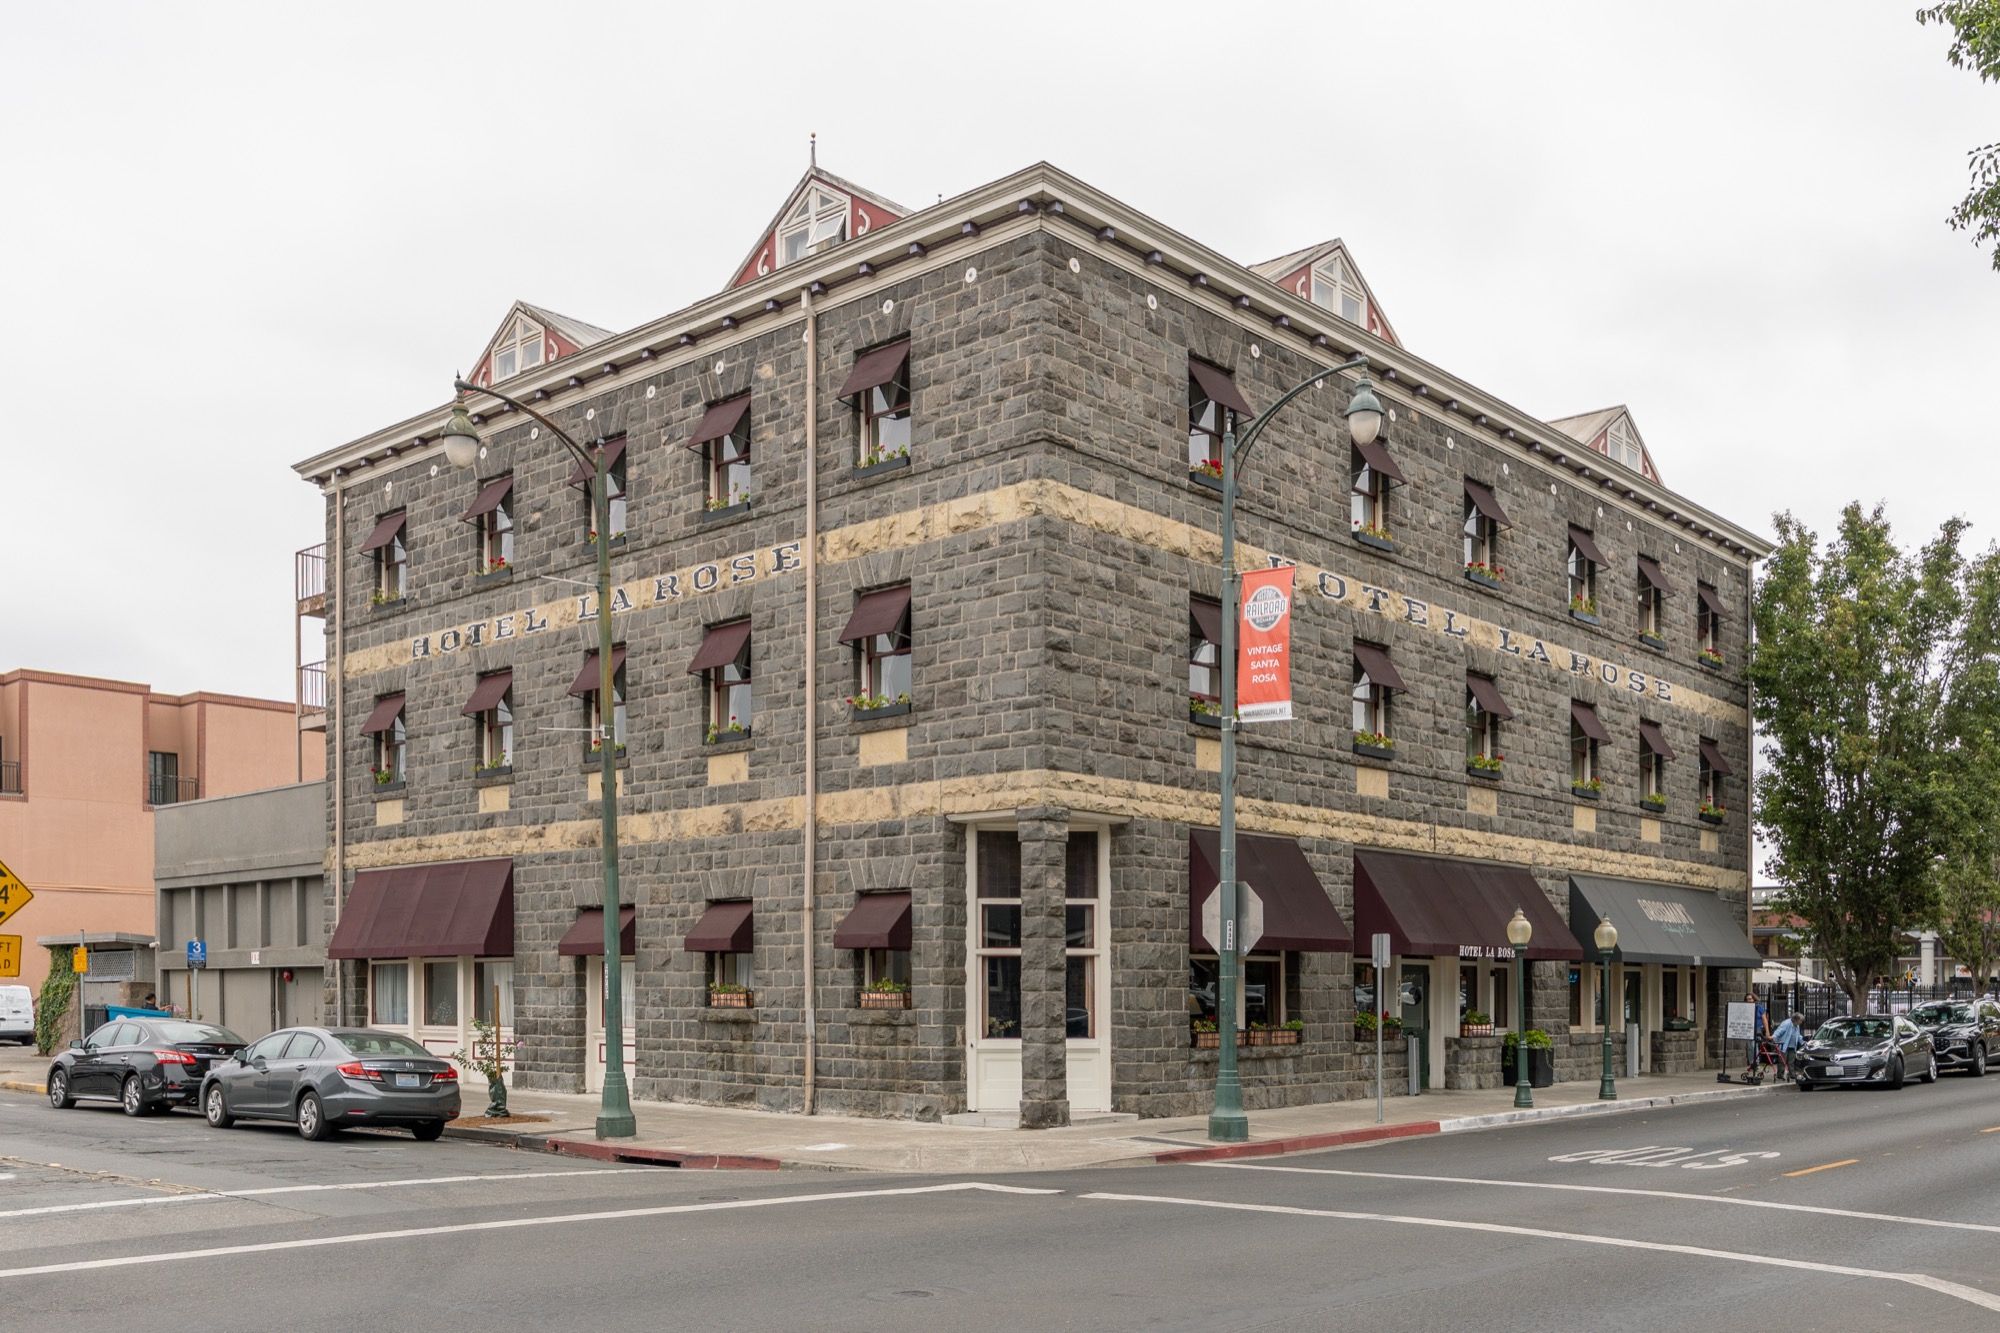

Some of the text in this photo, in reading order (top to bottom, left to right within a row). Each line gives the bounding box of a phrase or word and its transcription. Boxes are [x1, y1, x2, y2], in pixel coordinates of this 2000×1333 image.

[412, 543, 800, 658] HOTEL LA ROSE
[1246, 599, 1286, 617] RAILROAD
[1247, 643, 1282, 656] VINTAGE
[1250, 659, 1280, 670] SANTA
[1499, 629, 1551, 664] LA
[1570, 652, 1671, 702] ROSE
[1252, 673, 1277, 684] ROSA
[193, 941, 201, 953] 3
[1459, 945, 1515, 958] HOTEL LA ROSE
[1548, 1146, 1781, 1169] STOP
